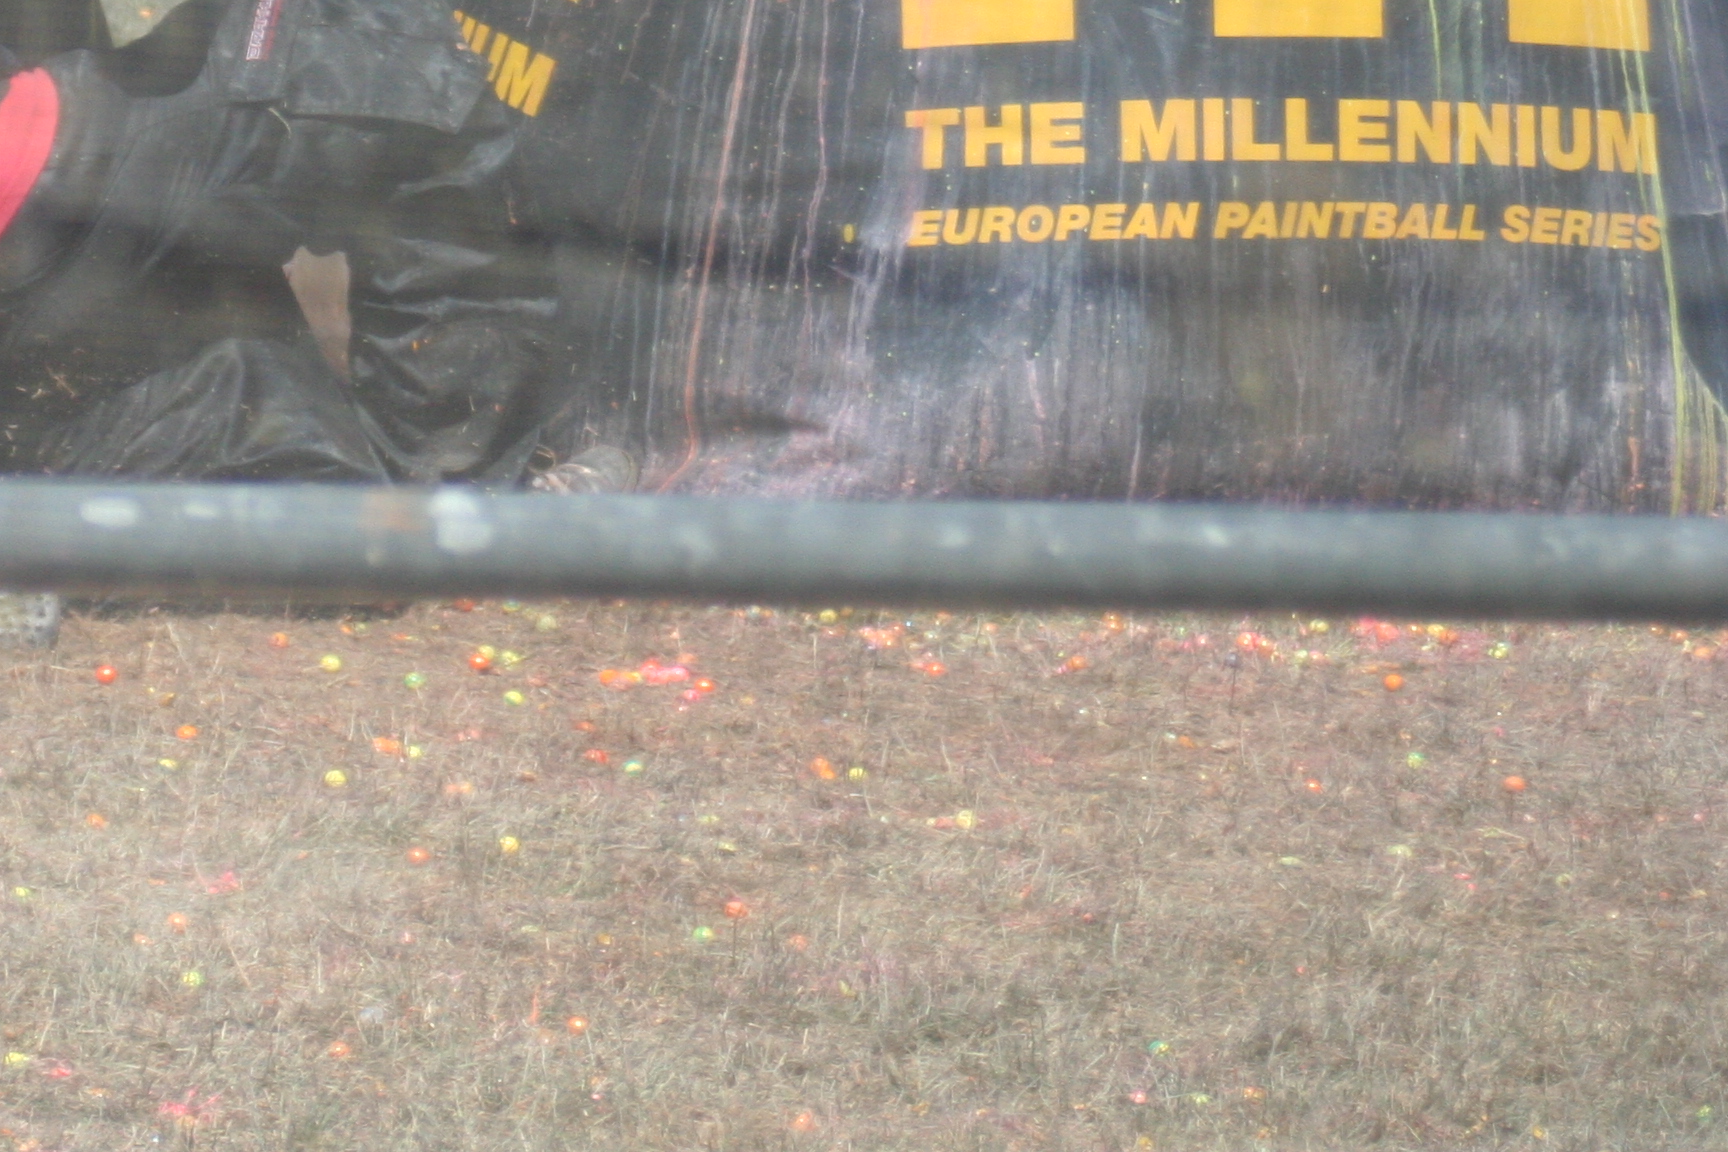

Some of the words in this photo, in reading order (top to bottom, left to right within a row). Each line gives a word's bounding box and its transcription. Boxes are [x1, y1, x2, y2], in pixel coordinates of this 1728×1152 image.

[904, 101, 1086, 170] THE
[1118, 97, 1658, 175] MILLENNIUM
[906, 201, 1199, 248] EUROPEAN
[1213, 200, 1485, 242] PAINTBALL
[1500, 204, 1664, 252] SERIES
